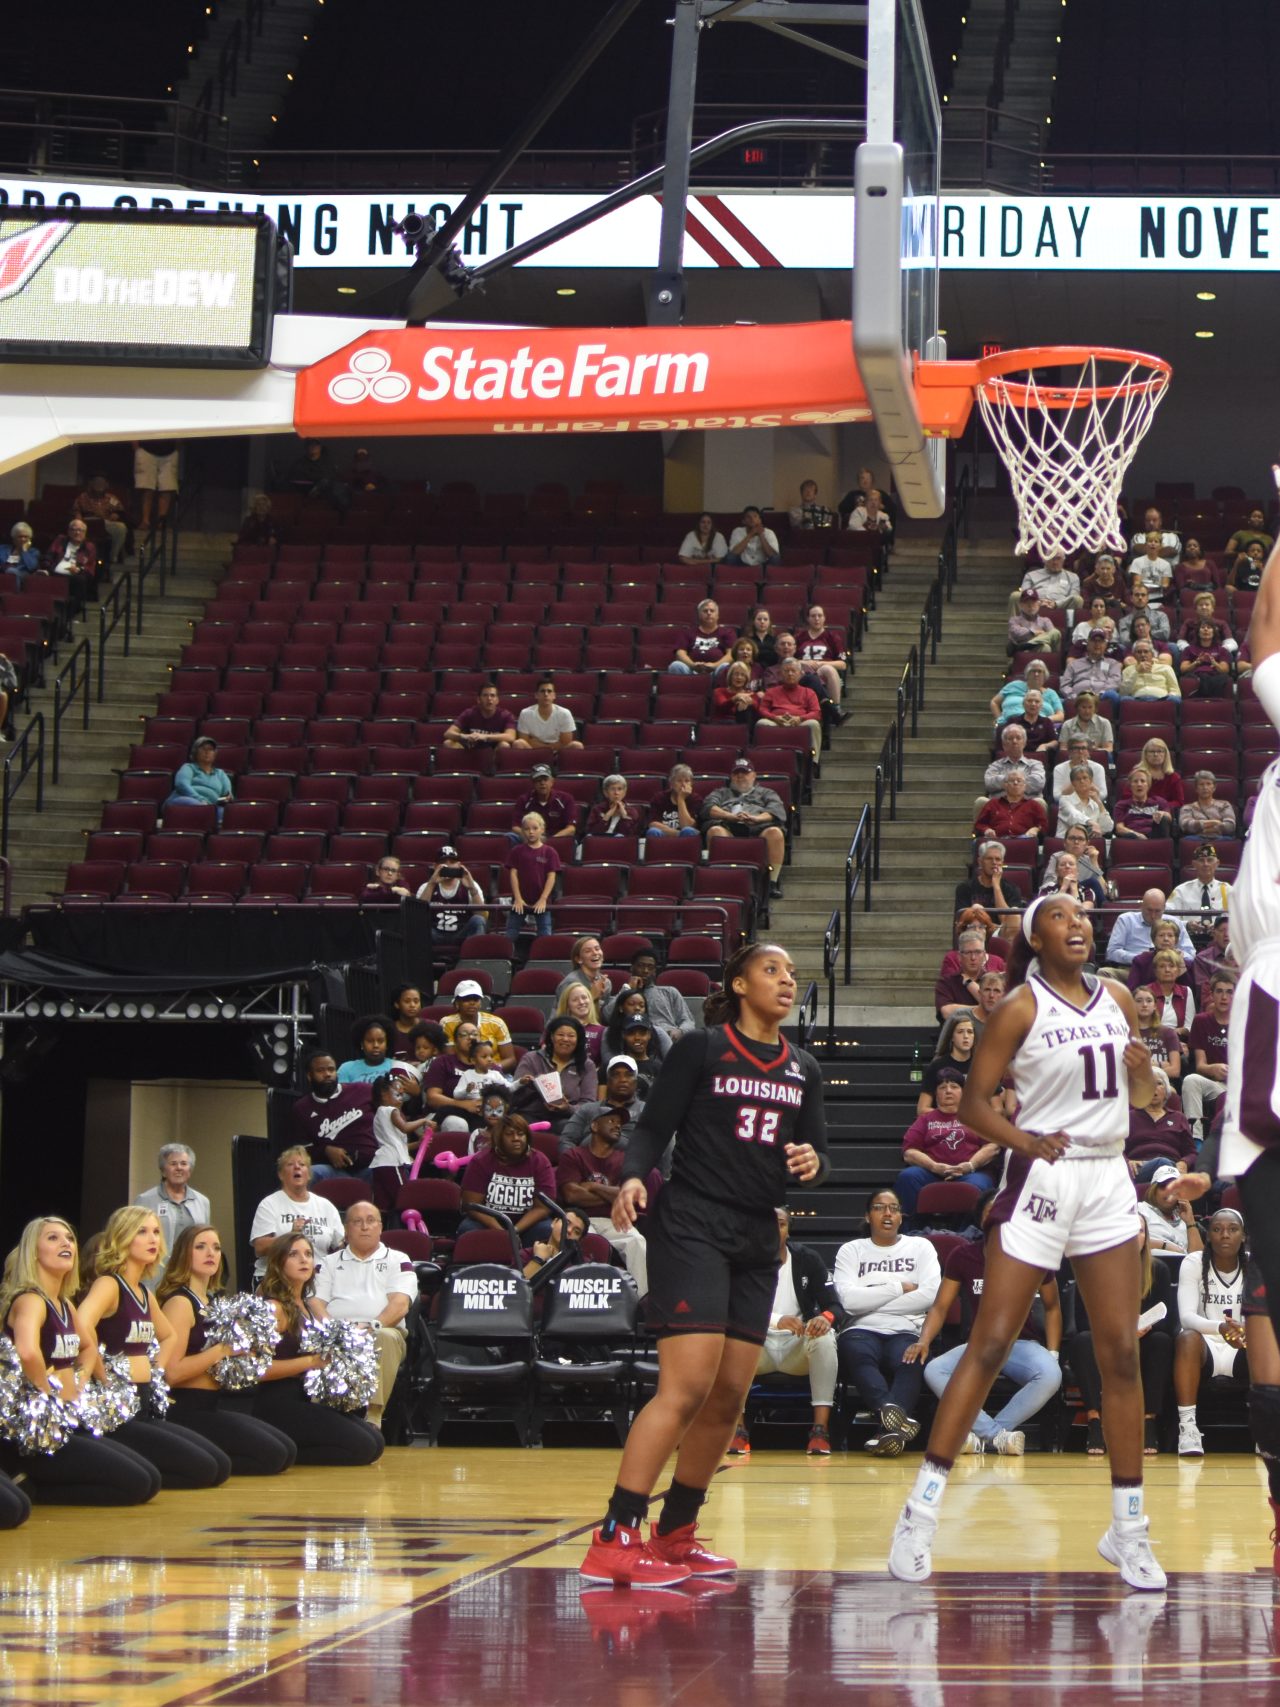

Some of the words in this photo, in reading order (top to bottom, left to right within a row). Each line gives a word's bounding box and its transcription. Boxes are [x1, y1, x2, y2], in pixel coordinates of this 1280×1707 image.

[904, 203, 1091, 257] RIDAY
[1042, 1025, 1101, 1049] TEXAS
[1078, 1042, 1119, 1101] 11
[713, 1076, 804, 1107] LOUISIANA
[318, 1107, 364, 1141] Aggies
[737, 1105, 781, 1144] 32
[486, 1182, 535, 1208] AGGIES
[858, 1257, 916, 1279] AGGIES
[453, 1279, 517, 1295] MUSCLE
[559, 1278, 622, 1294] MUSCLE
